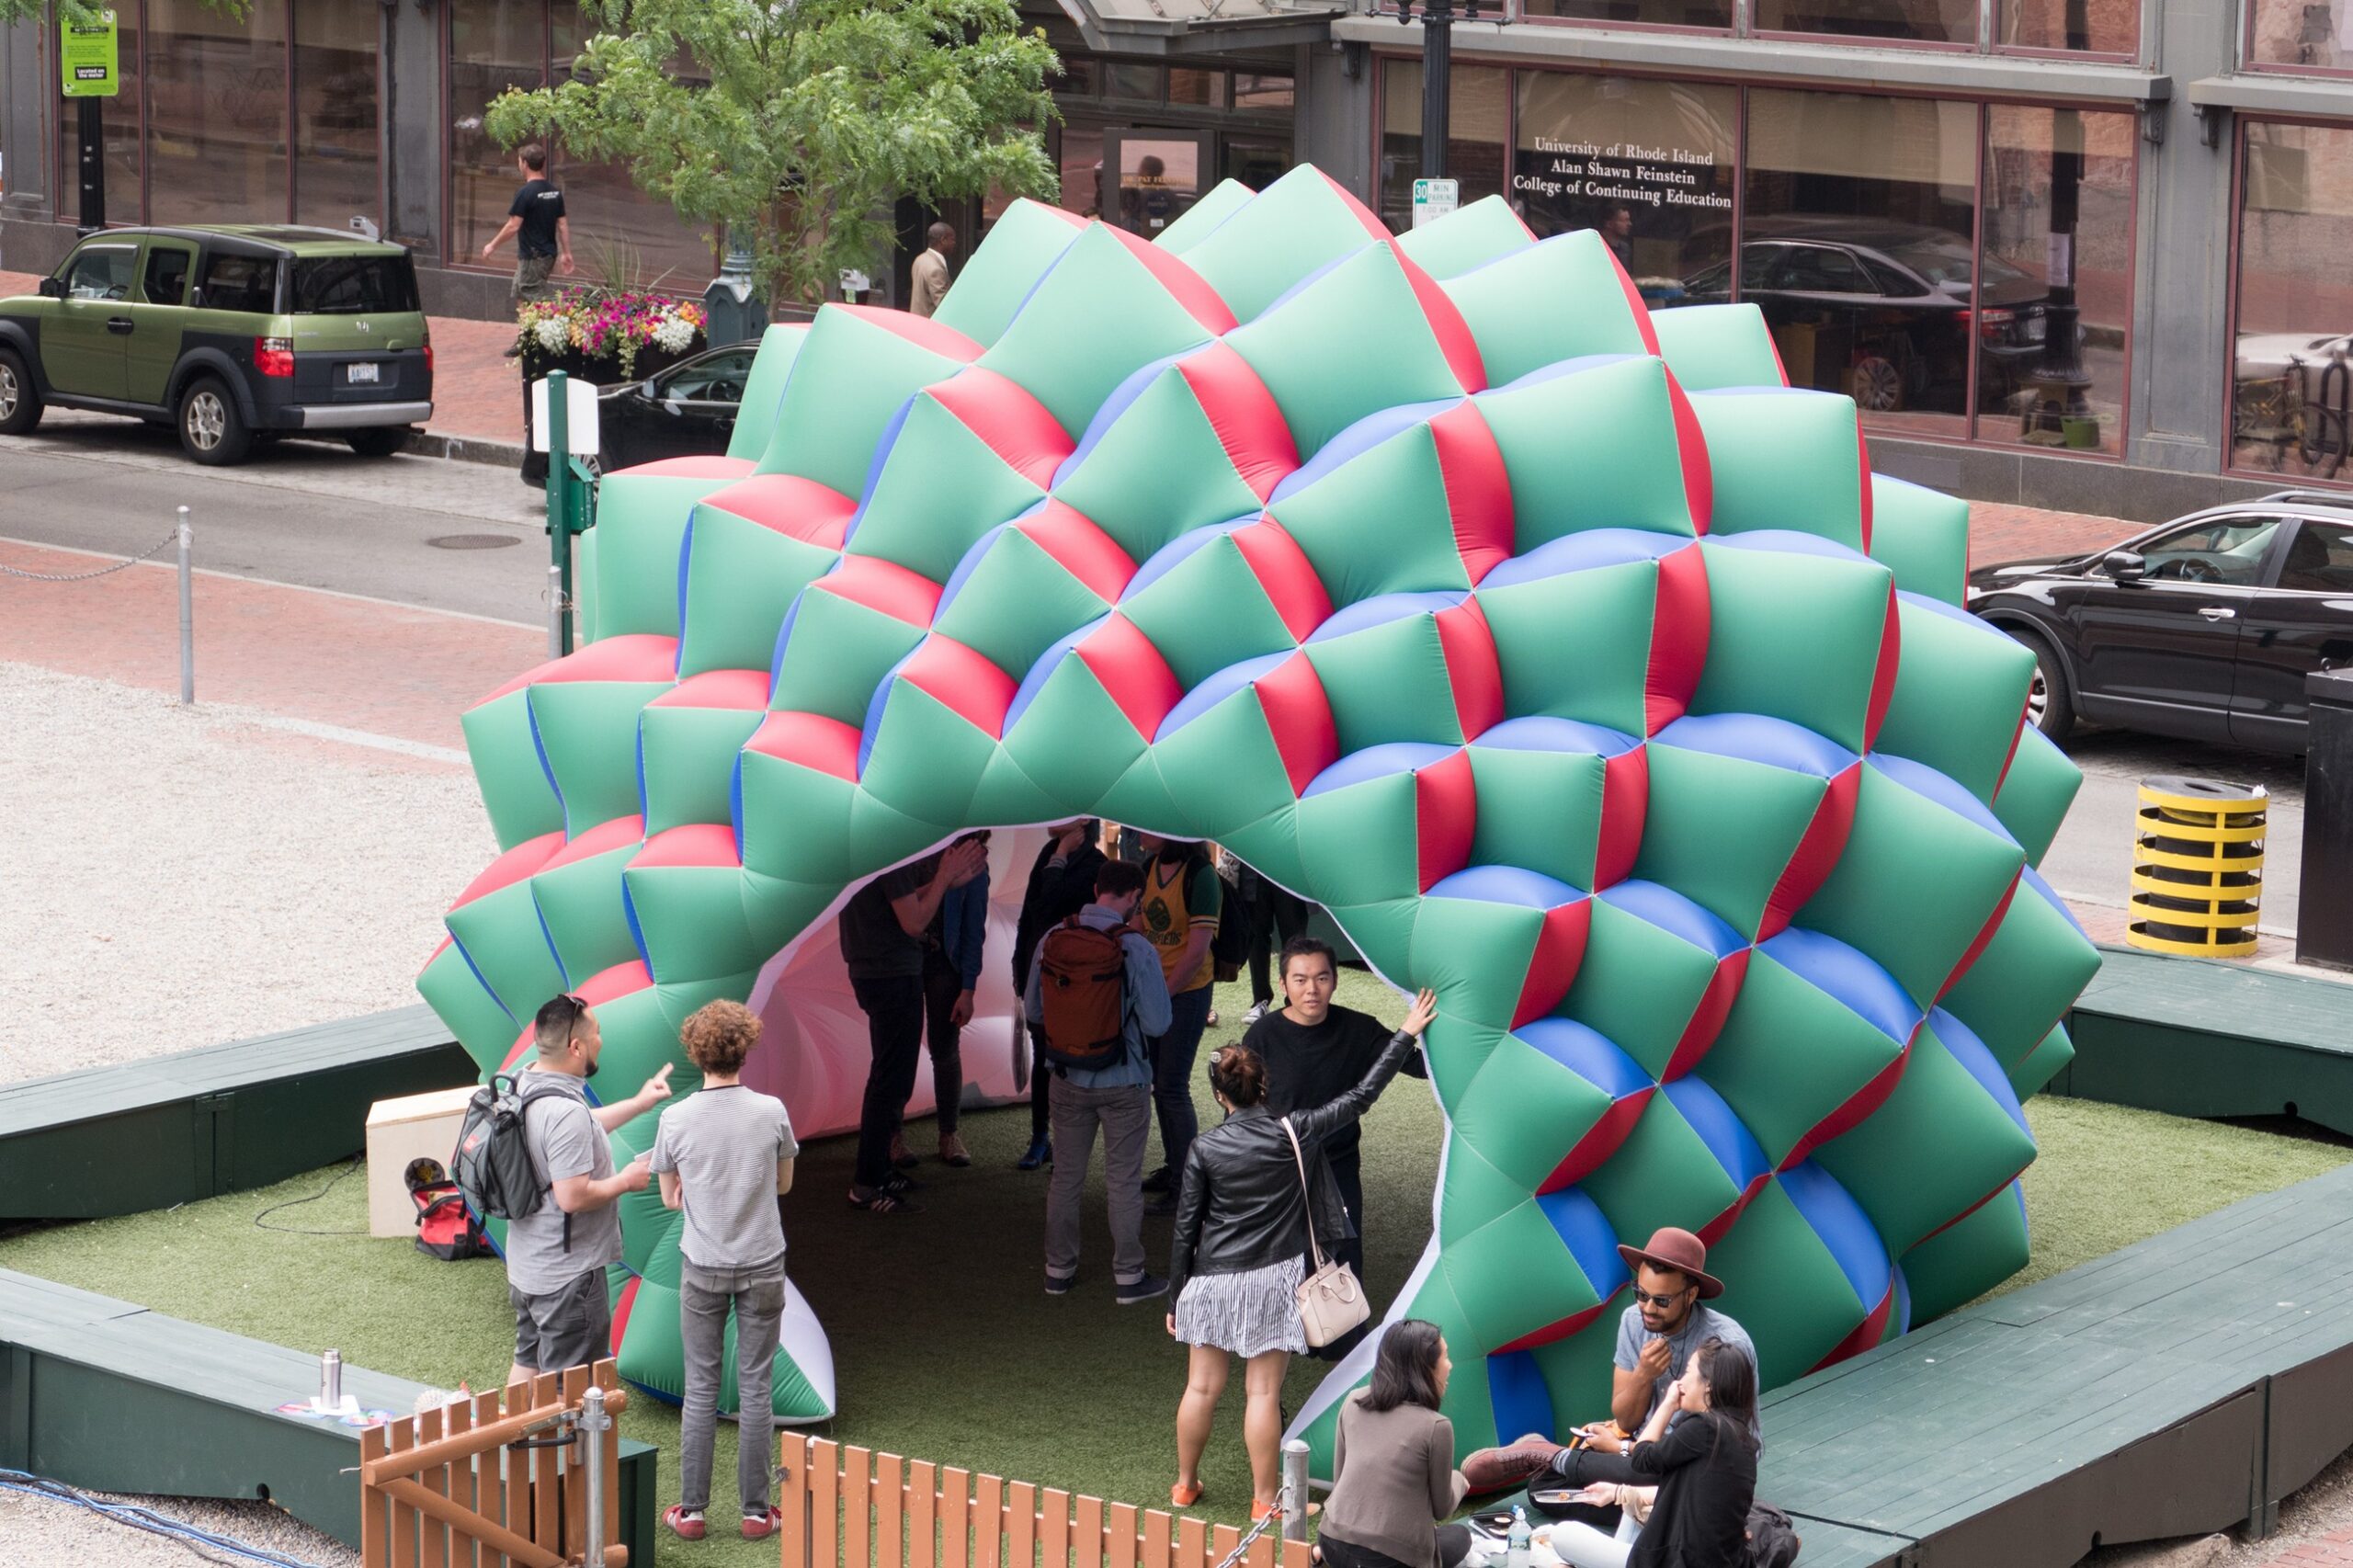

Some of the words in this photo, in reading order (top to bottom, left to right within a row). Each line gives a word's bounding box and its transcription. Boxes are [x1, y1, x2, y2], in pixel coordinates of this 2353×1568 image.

[1534, 136, 1601, 159] University
[1606, 143, 1621, 157] of
[1625, 144, 1667, 162] Rhode
[1672, 148, 1713, 165] Island
[1551, 158, 1583, 175] Alan
[1587, 162, 1631, 178] Shawn
[1635, 165, 1696, 185] Feinstein
[1415, 184, 1427, 199] 30
[1433, 184, 1449, 192] MIN
[1513, 175, 1562, 198] College
[1566, 180, 1582, 194] of
[1585, 181, 1662, 207] Continuing
[1665, 188, 1733, 209] Education
